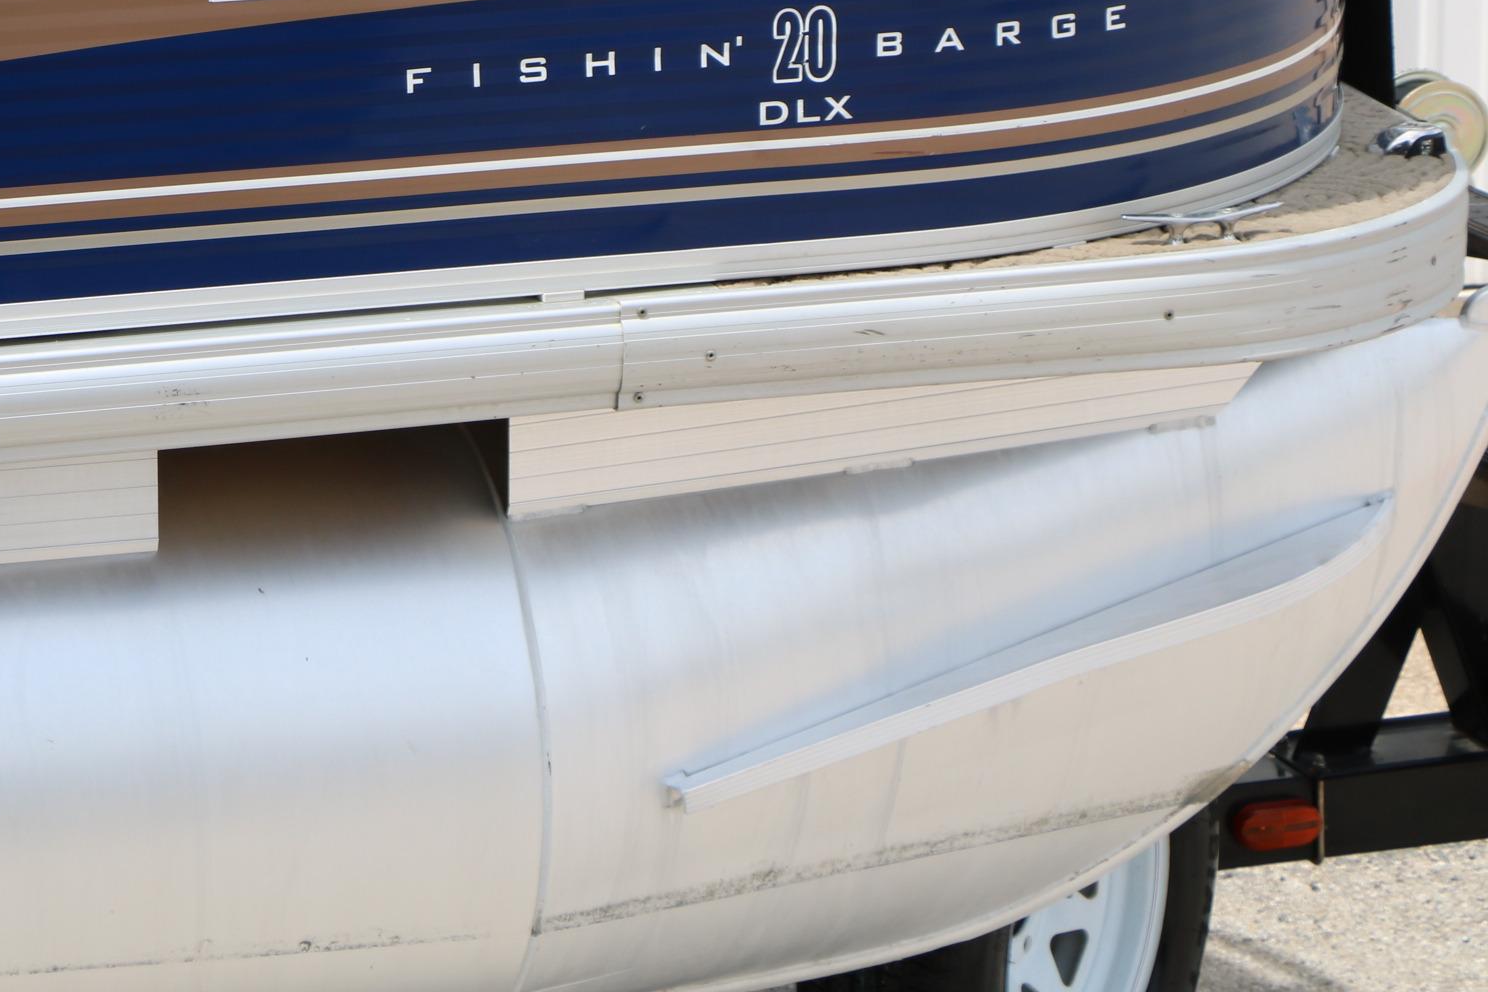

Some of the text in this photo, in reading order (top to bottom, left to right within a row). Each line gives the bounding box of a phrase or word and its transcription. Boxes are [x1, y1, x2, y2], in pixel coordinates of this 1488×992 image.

[407, 5, 1126, 93] FISHIN' 20 BARGE
[759, 95, 853, 125] DLX
